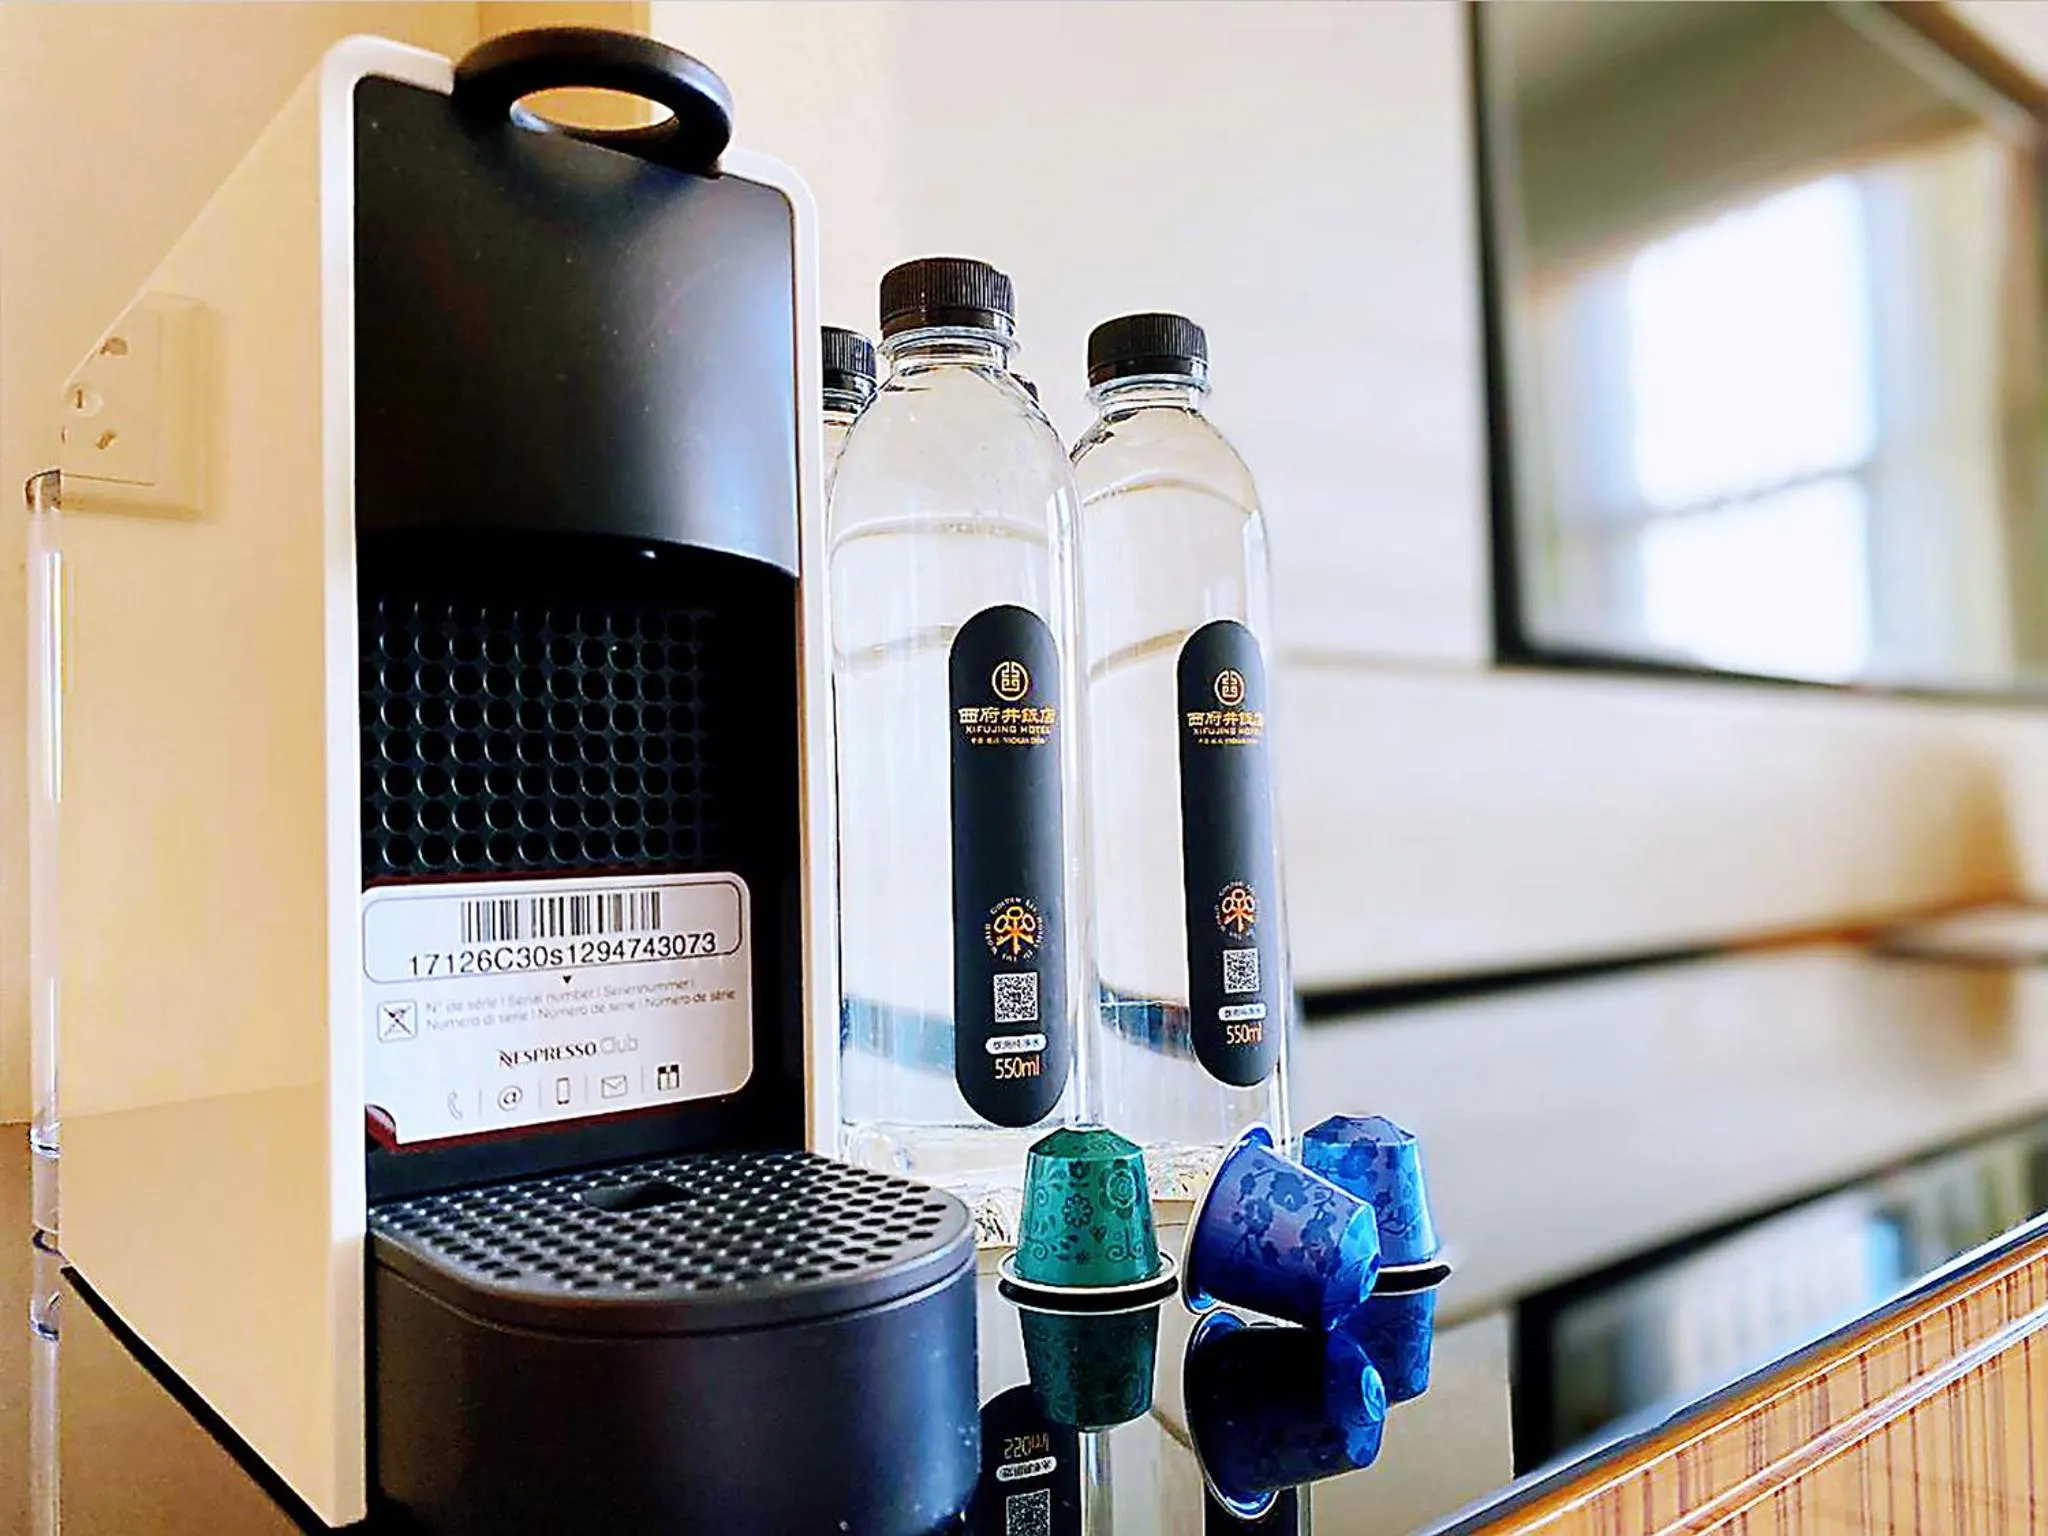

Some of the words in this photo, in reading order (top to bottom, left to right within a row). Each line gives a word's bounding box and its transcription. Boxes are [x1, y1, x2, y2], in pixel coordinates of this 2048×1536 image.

[966, 725, 1017, 734] XIFUJING
[1020, 725, 1050, 734] HOTEL
[410, 932, 716, 976] 17126C30s1294743073
[546, 986, 594, 1003] number
[693, 991, 707, 1004] de
[1226, 1021, 1263, 1045] 550ml
[499, 1041, 598, 1068] NESPRESSO
[600, 1036, 638, 1054] Club
[994, 1055, 1040, 1079] 550ml
